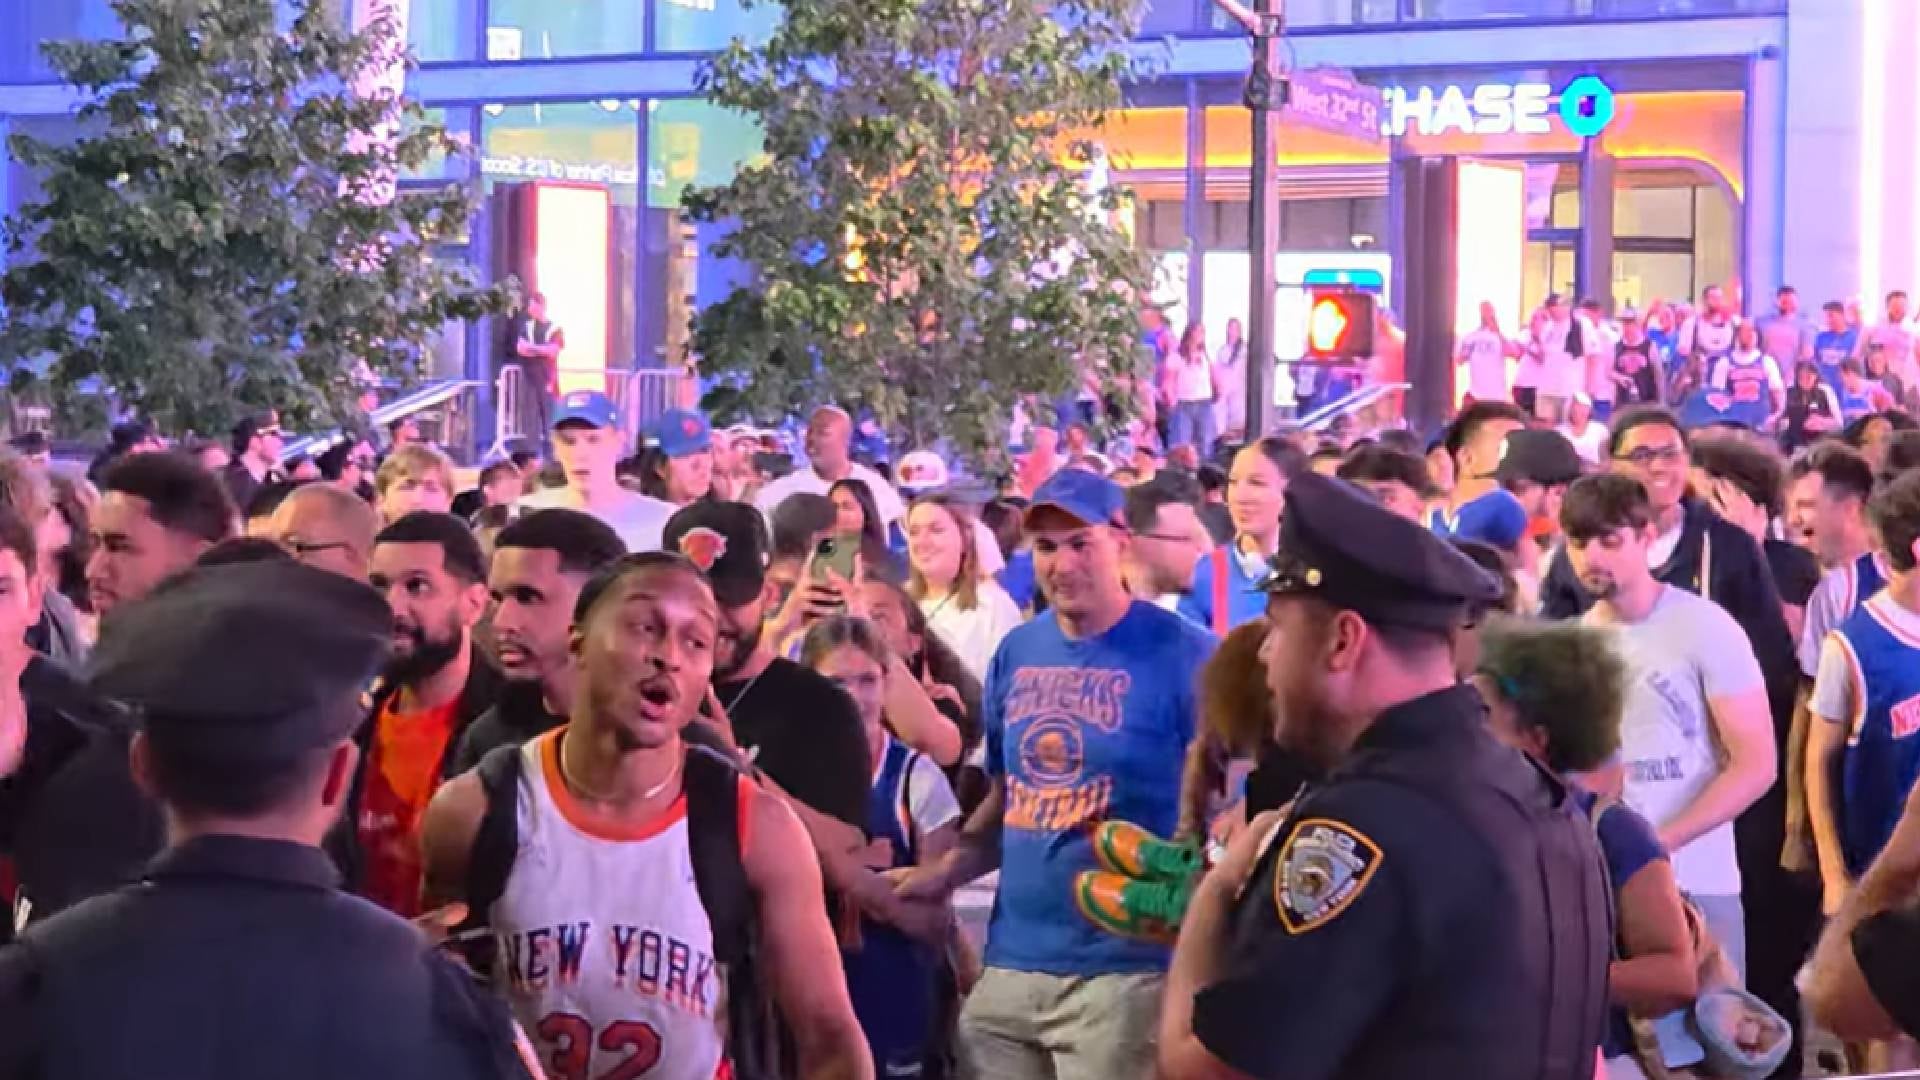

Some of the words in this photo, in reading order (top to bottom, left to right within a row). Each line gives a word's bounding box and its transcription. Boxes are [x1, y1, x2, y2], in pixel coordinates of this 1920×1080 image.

[1291, 84, 1328, 118] West
[1381, 83, 1551, 136] HASE
[505, 921, 591, 987] NEW
[610, 924, 715, 1014] YORK
[536, 1012, 662, 1080] 32
